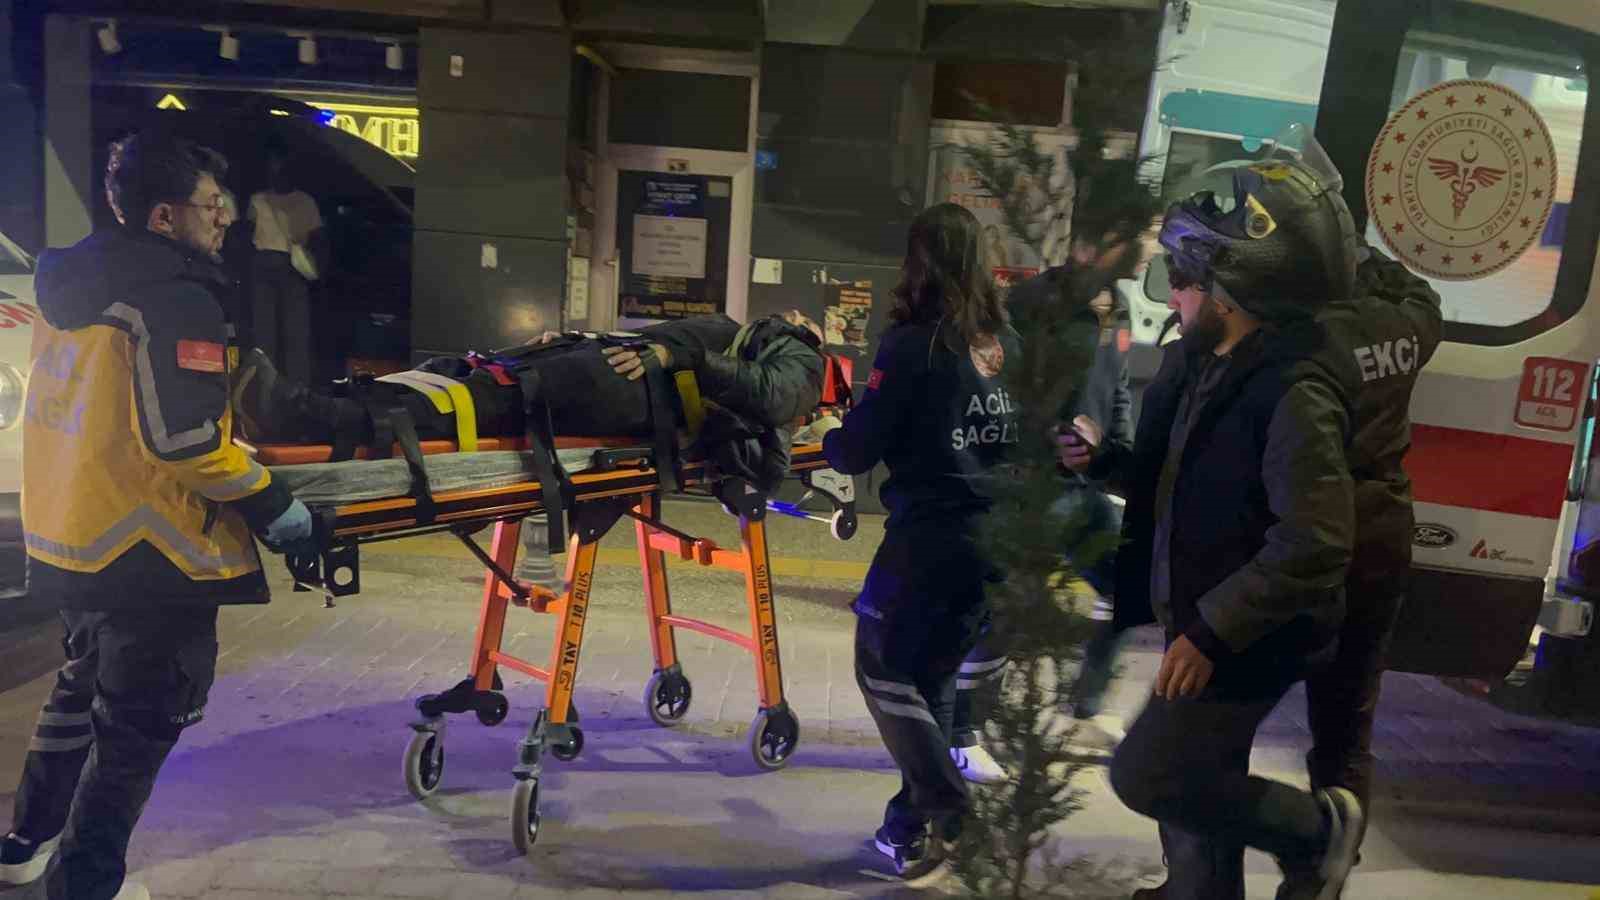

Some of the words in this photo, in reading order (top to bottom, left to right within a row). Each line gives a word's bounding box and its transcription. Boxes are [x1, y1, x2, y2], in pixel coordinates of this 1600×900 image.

[1353, 335, 1419, 382] EKÇİ
[1531, 365, 1575, 401] 112
[964, 387, 1016, 416] ACİL
[575, 571, 591, 601] PLUS
[756, 564, 769, 589] PLUS
[573, 604, 584, 618] 10
[762, 624, 775, 645] TAY
[563, 641, 577, 664] TAY
